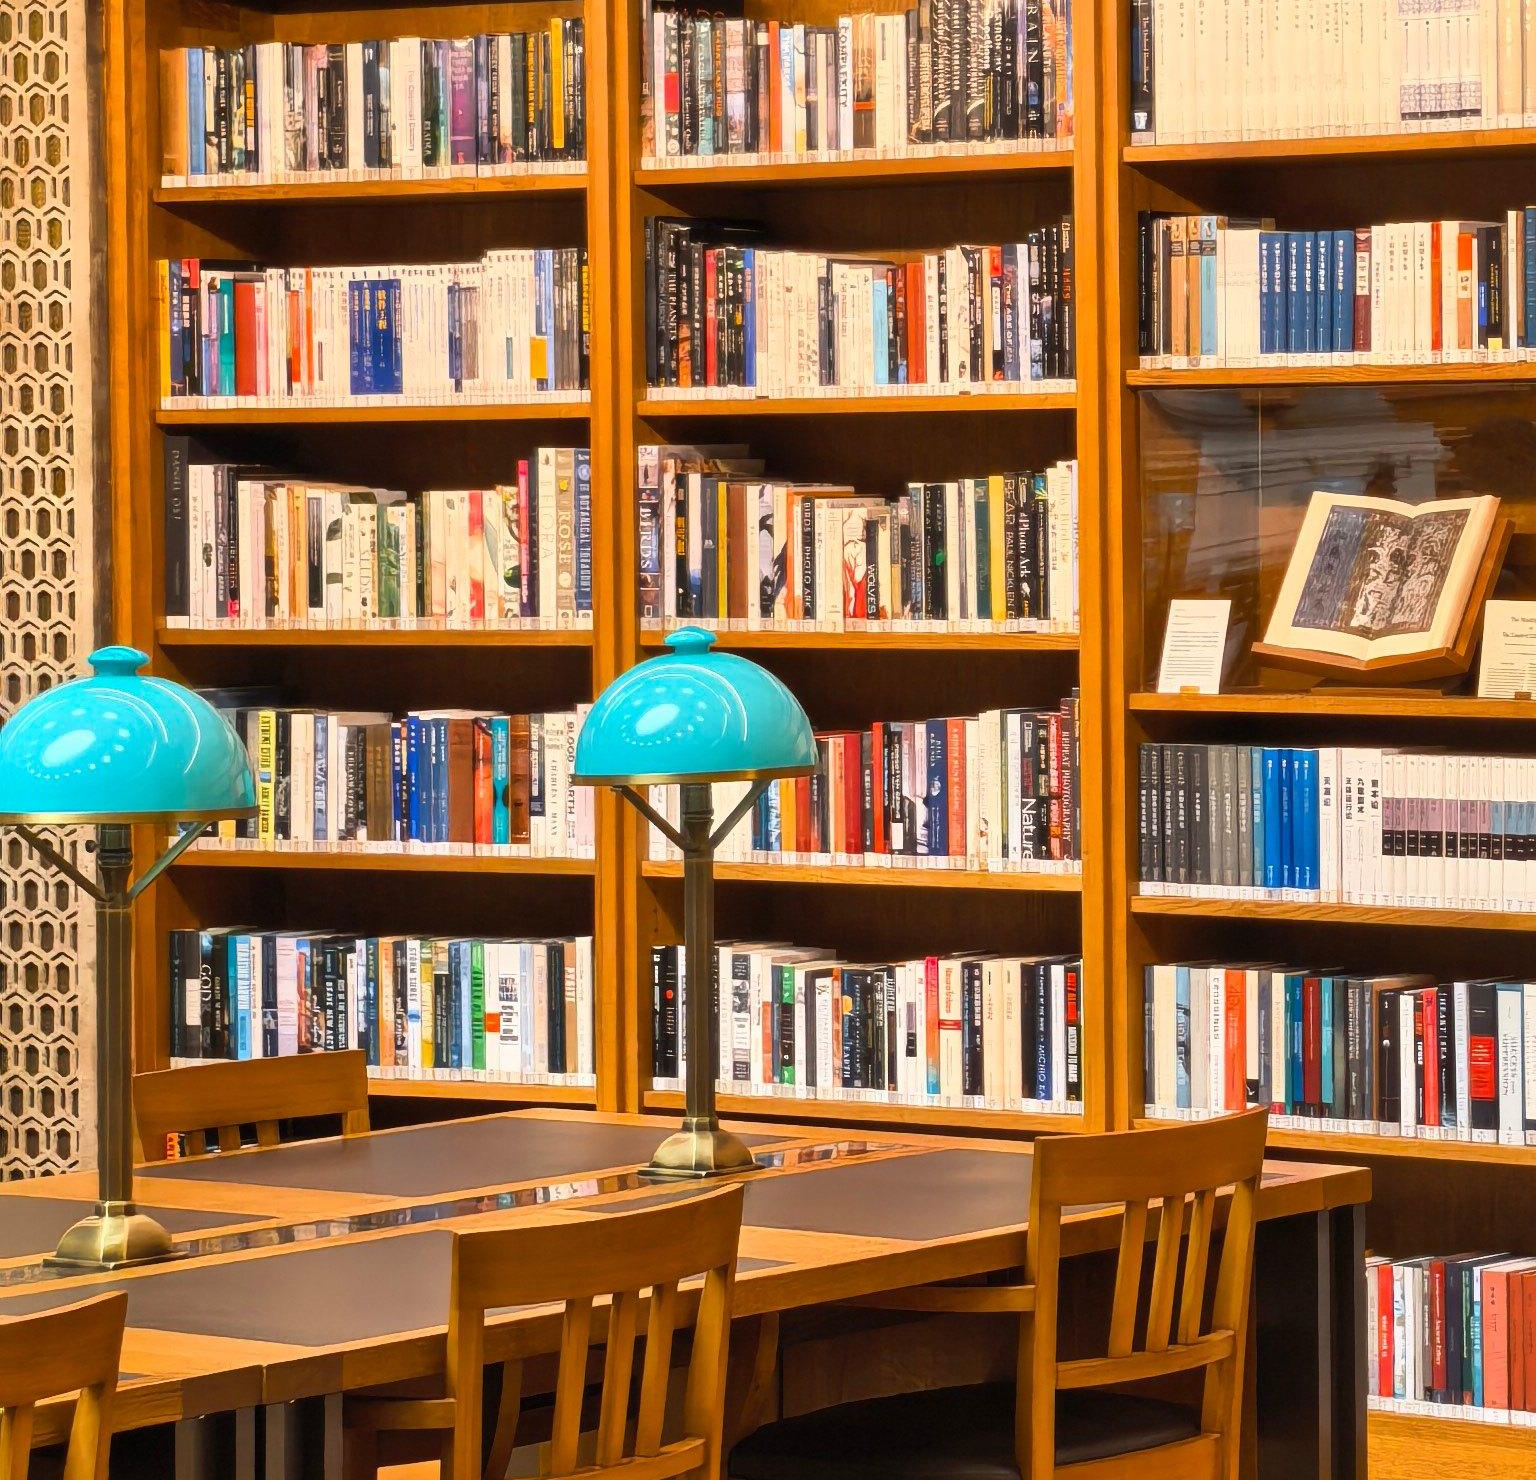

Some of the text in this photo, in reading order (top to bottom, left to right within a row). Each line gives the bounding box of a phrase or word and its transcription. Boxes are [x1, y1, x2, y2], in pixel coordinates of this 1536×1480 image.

[639, 505, 651, 569] BIRDS
[867, 563, 875, 613] WOLVES
[567, 721, 575, 762] BLOOD
[1062, 731, 1070, 842] REPEAT PHOTOGRAPHY
[1021, 798, 1037, 861] Nature
[1038, 1044, 1046, 1082] MICHIO
